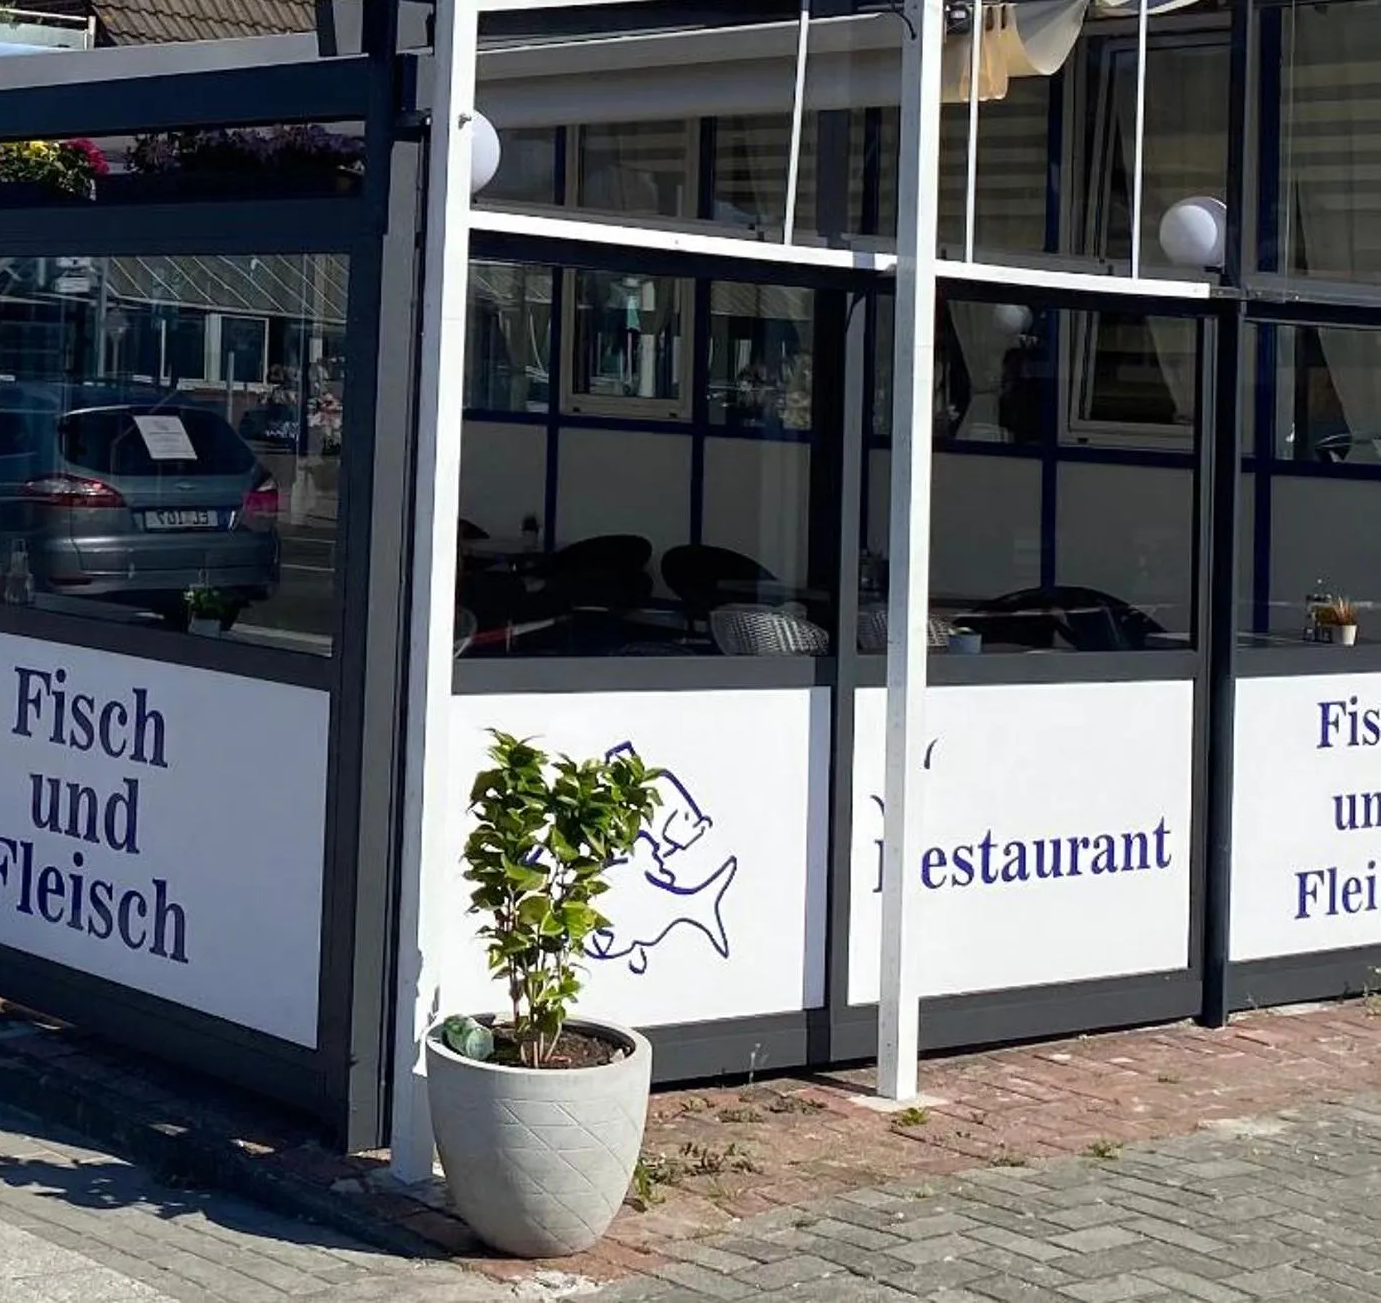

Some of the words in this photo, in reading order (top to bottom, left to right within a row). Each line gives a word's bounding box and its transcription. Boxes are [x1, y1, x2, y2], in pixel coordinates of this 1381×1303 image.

[11, 665, 169, 769] Fisch
[29, 771, 141, 855] und
[872, 815, 1172, 894] estaurant
[1294, 859, 1378, 920] Flei
